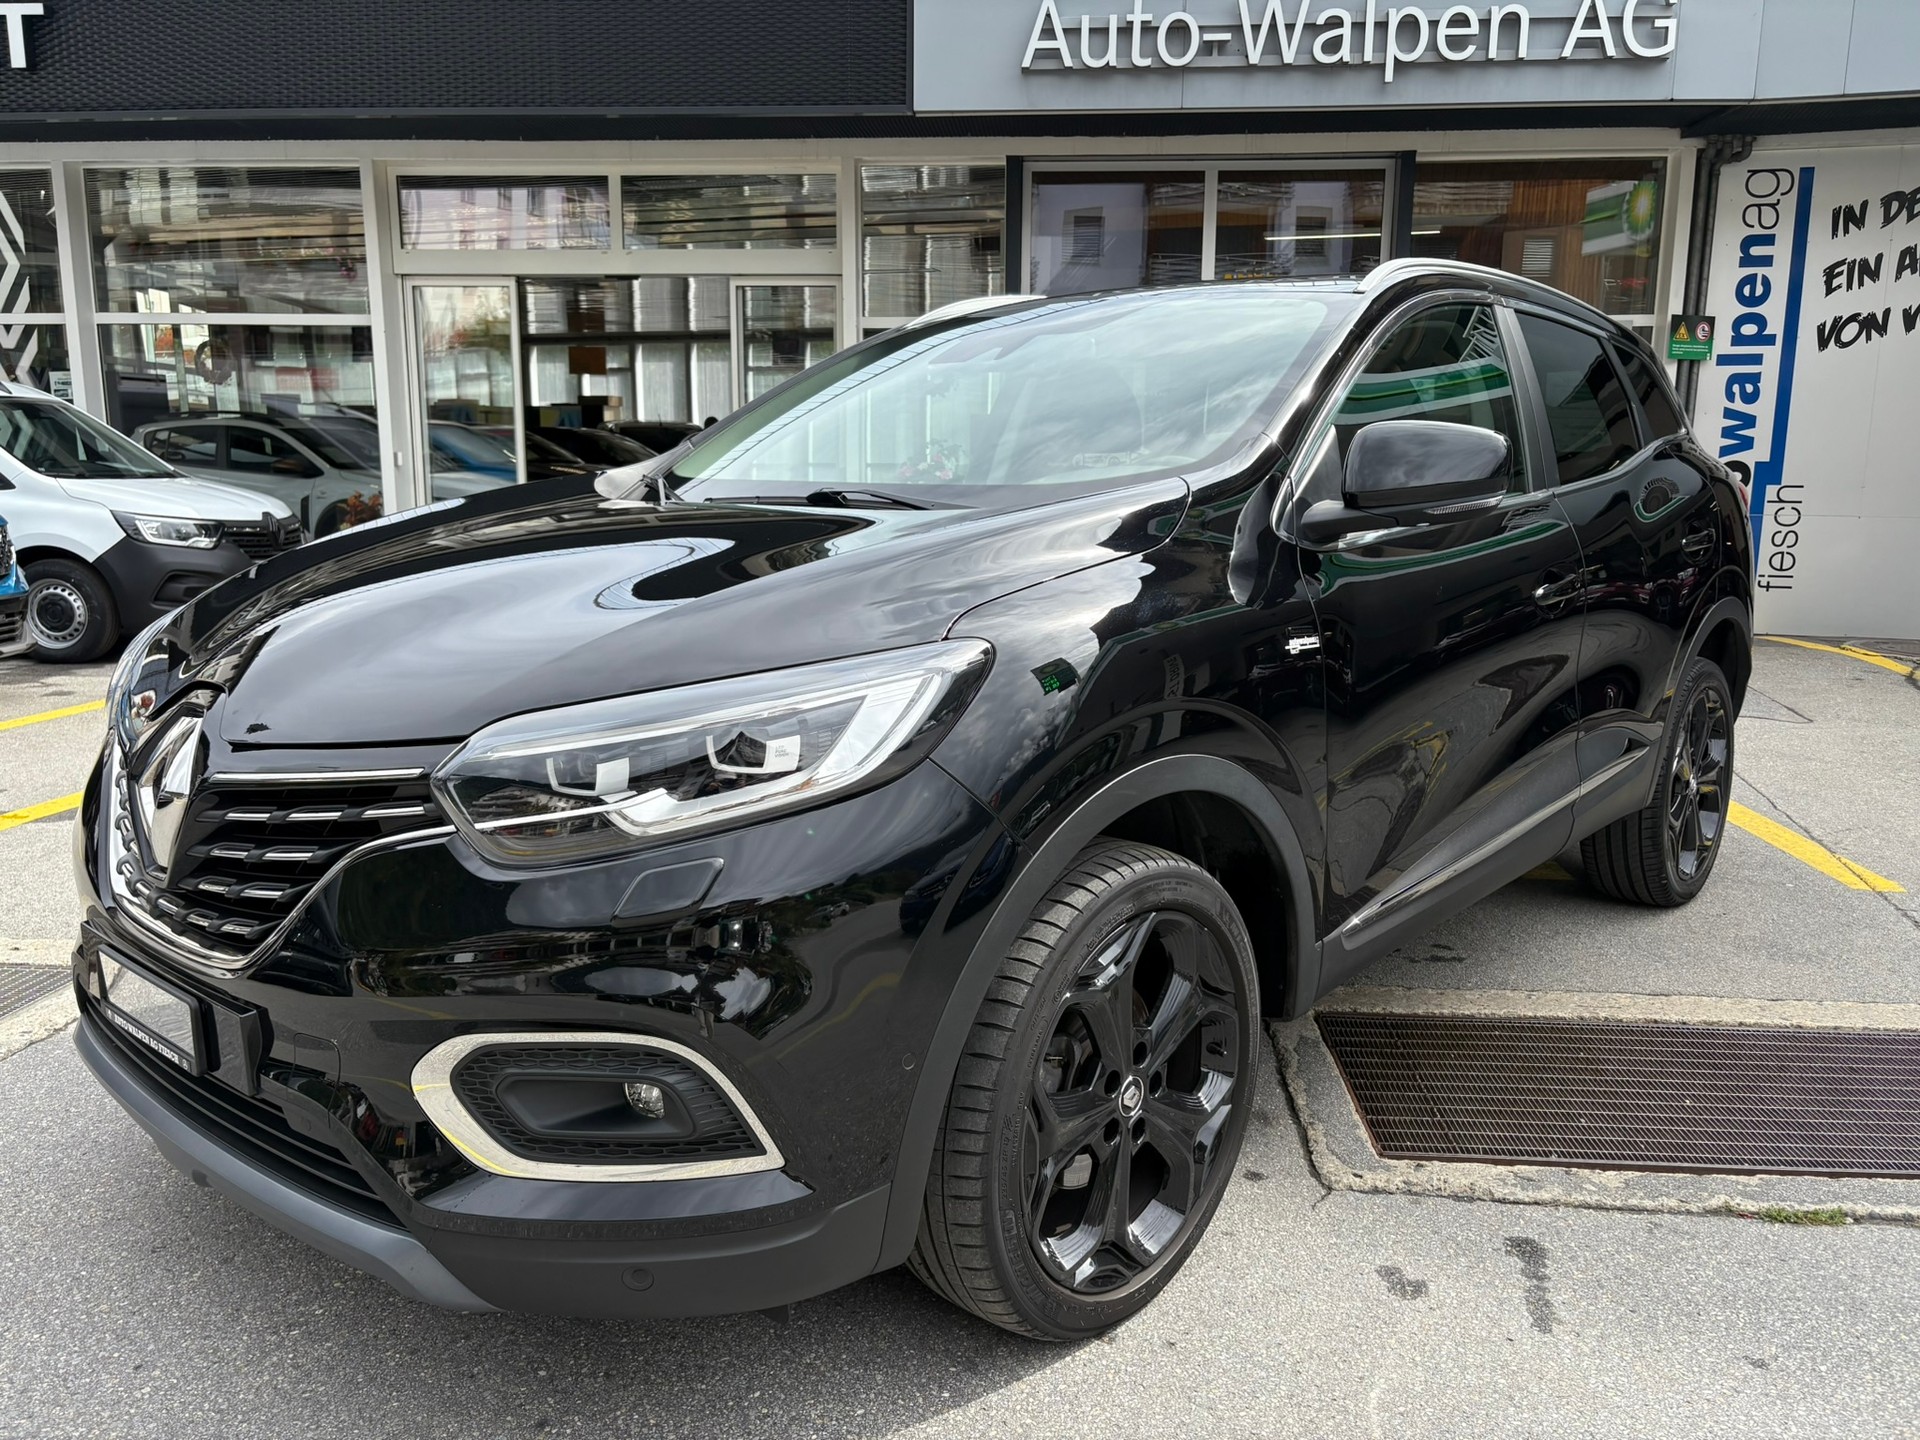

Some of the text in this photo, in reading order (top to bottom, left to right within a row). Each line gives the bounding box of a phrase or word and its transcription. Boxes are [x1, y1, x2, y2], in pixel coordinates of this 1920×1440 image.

[0, 3, 43, 68] T
[1022, 0, 1678, 82] Auto-Walpen AG
[1831, 198, 1870, 240] IN
[1822, 243, 1920, 298] EIN A
[1816, 306, 1892, 353] VON
[1757, 484, 1805, 593] fiesch
